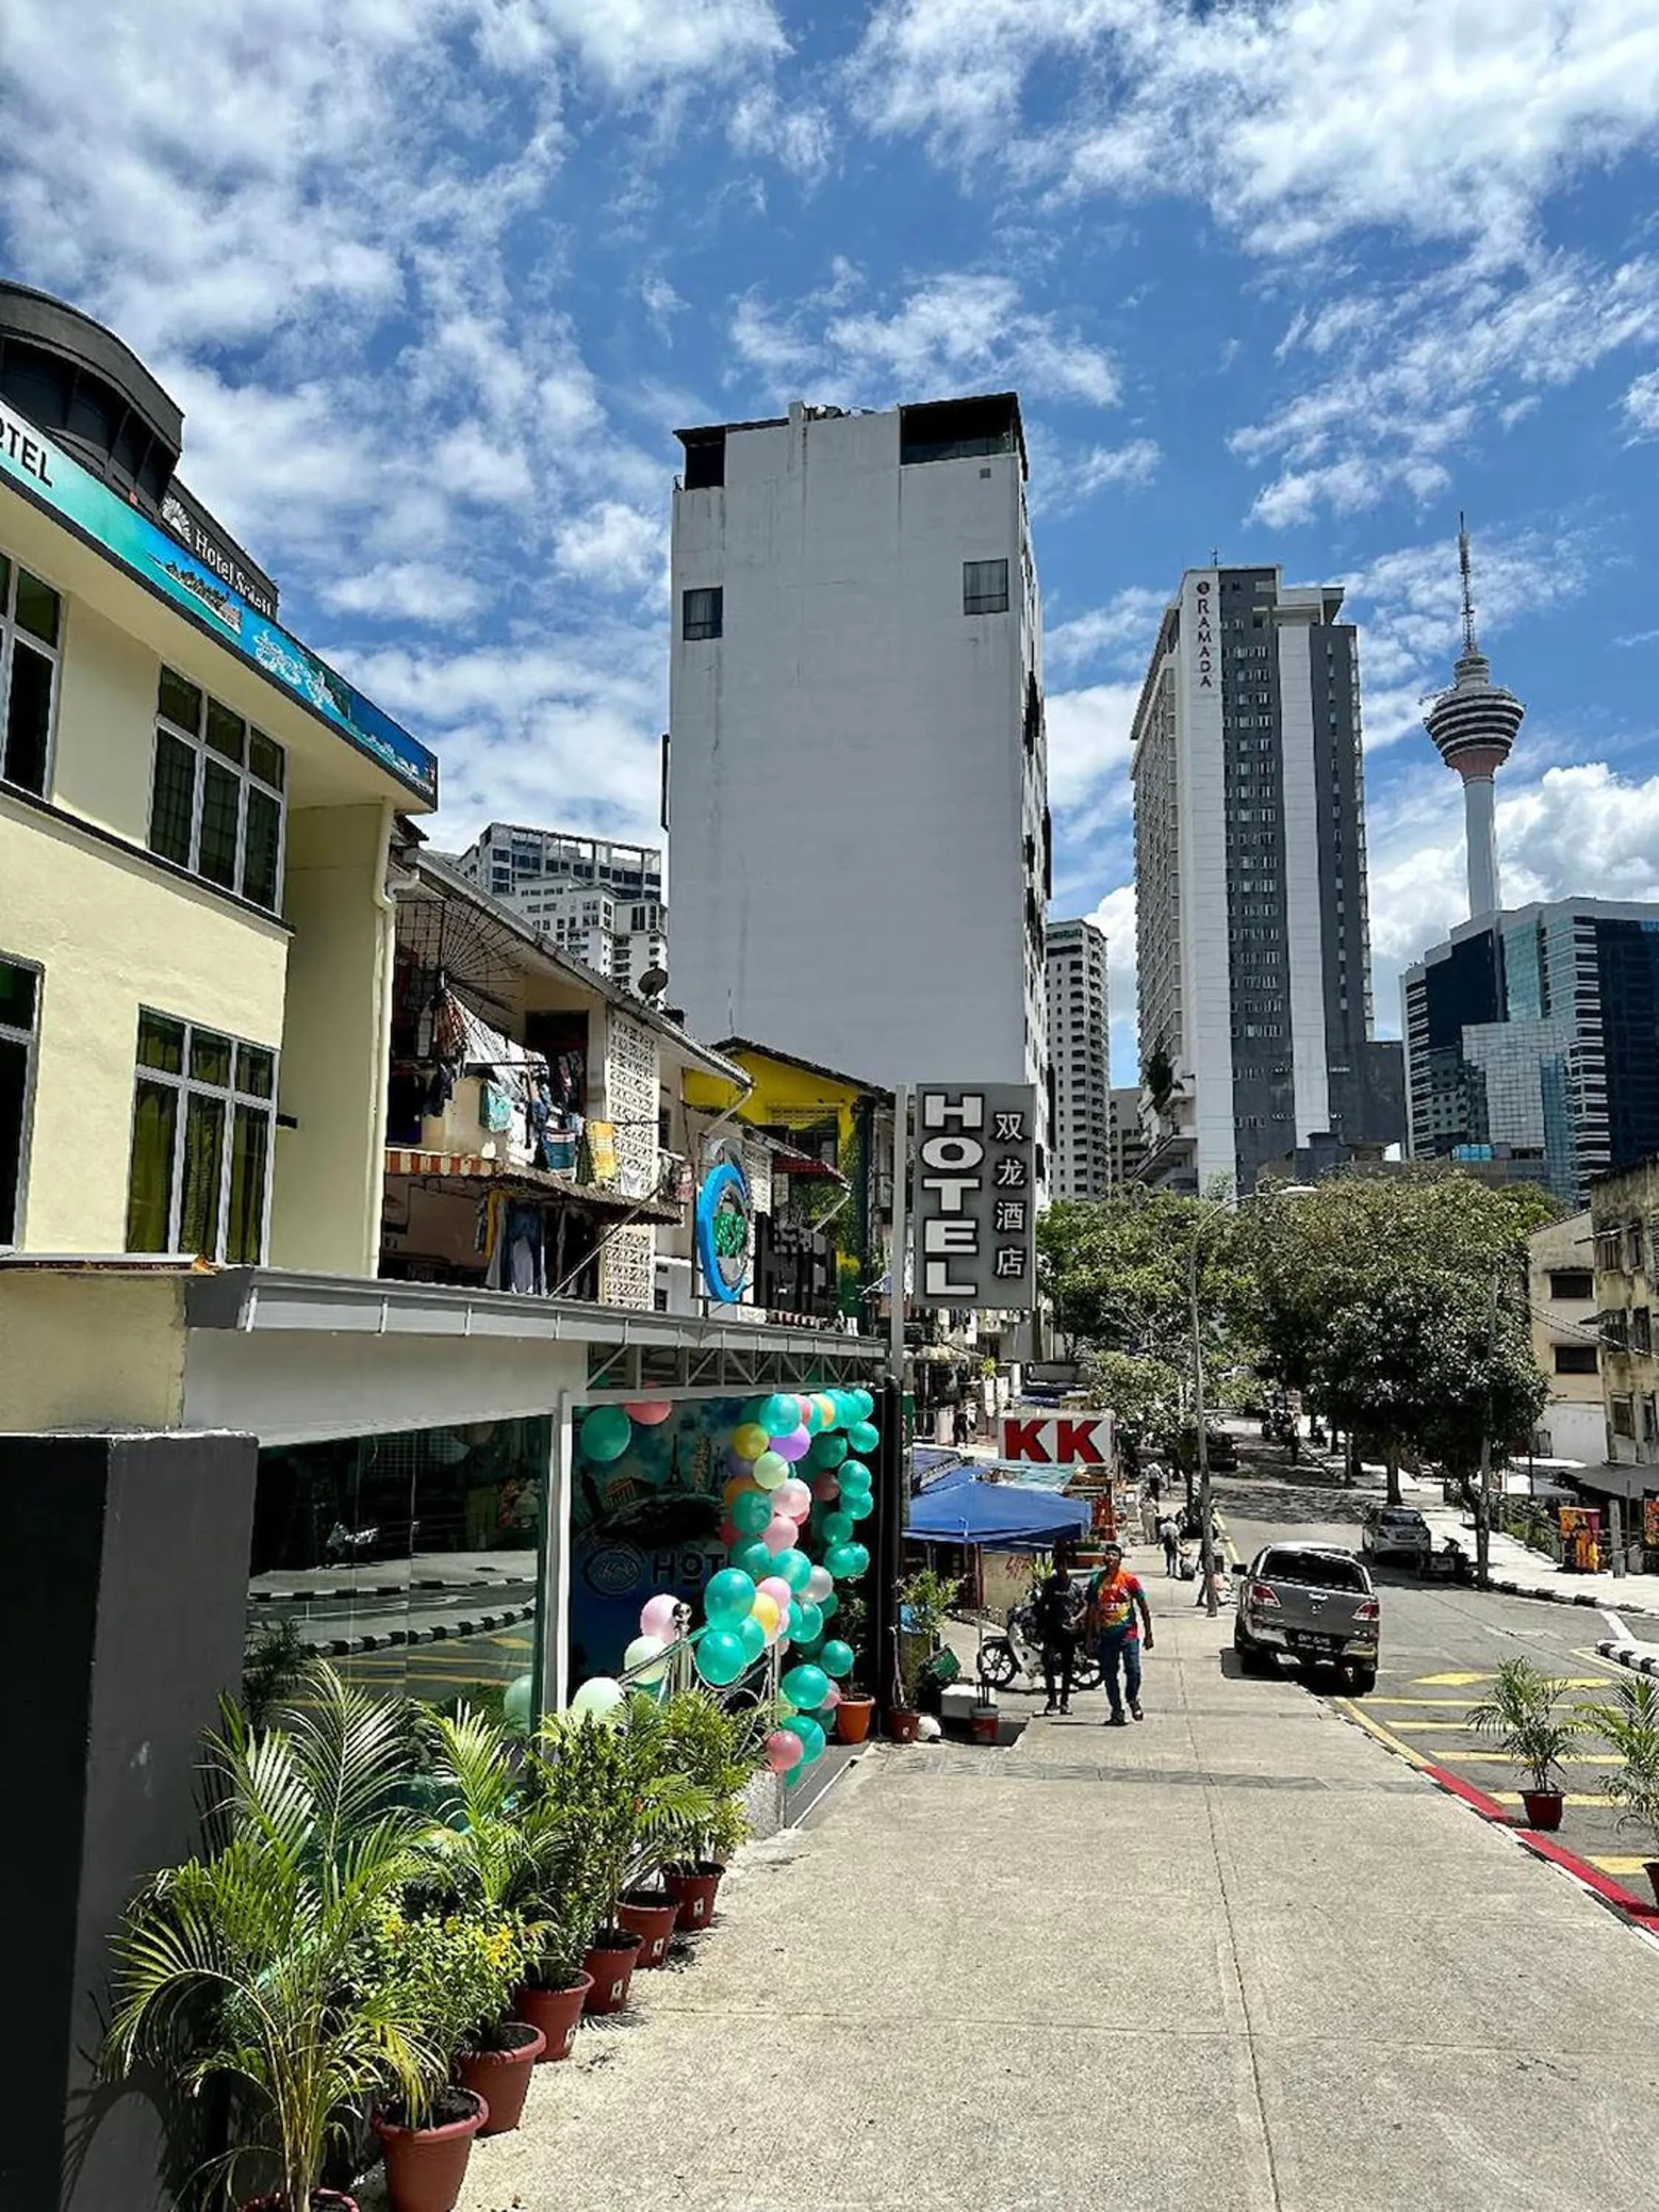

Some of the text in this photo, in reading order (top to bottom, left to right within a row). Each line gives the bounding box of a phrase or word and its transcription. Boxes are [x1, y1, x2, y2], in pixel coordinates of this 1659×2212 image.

[0, 417, 53, 488] TEL
[195, 528, 234, 585] Hotel
[1197, 598, 1211, 687] RAMADA
[922, 1093, 984, 1295] HOTEL
[995, 1113, 1025, 1277] 双龙酒店
[1004, 1419, 1105, 1464] KK
